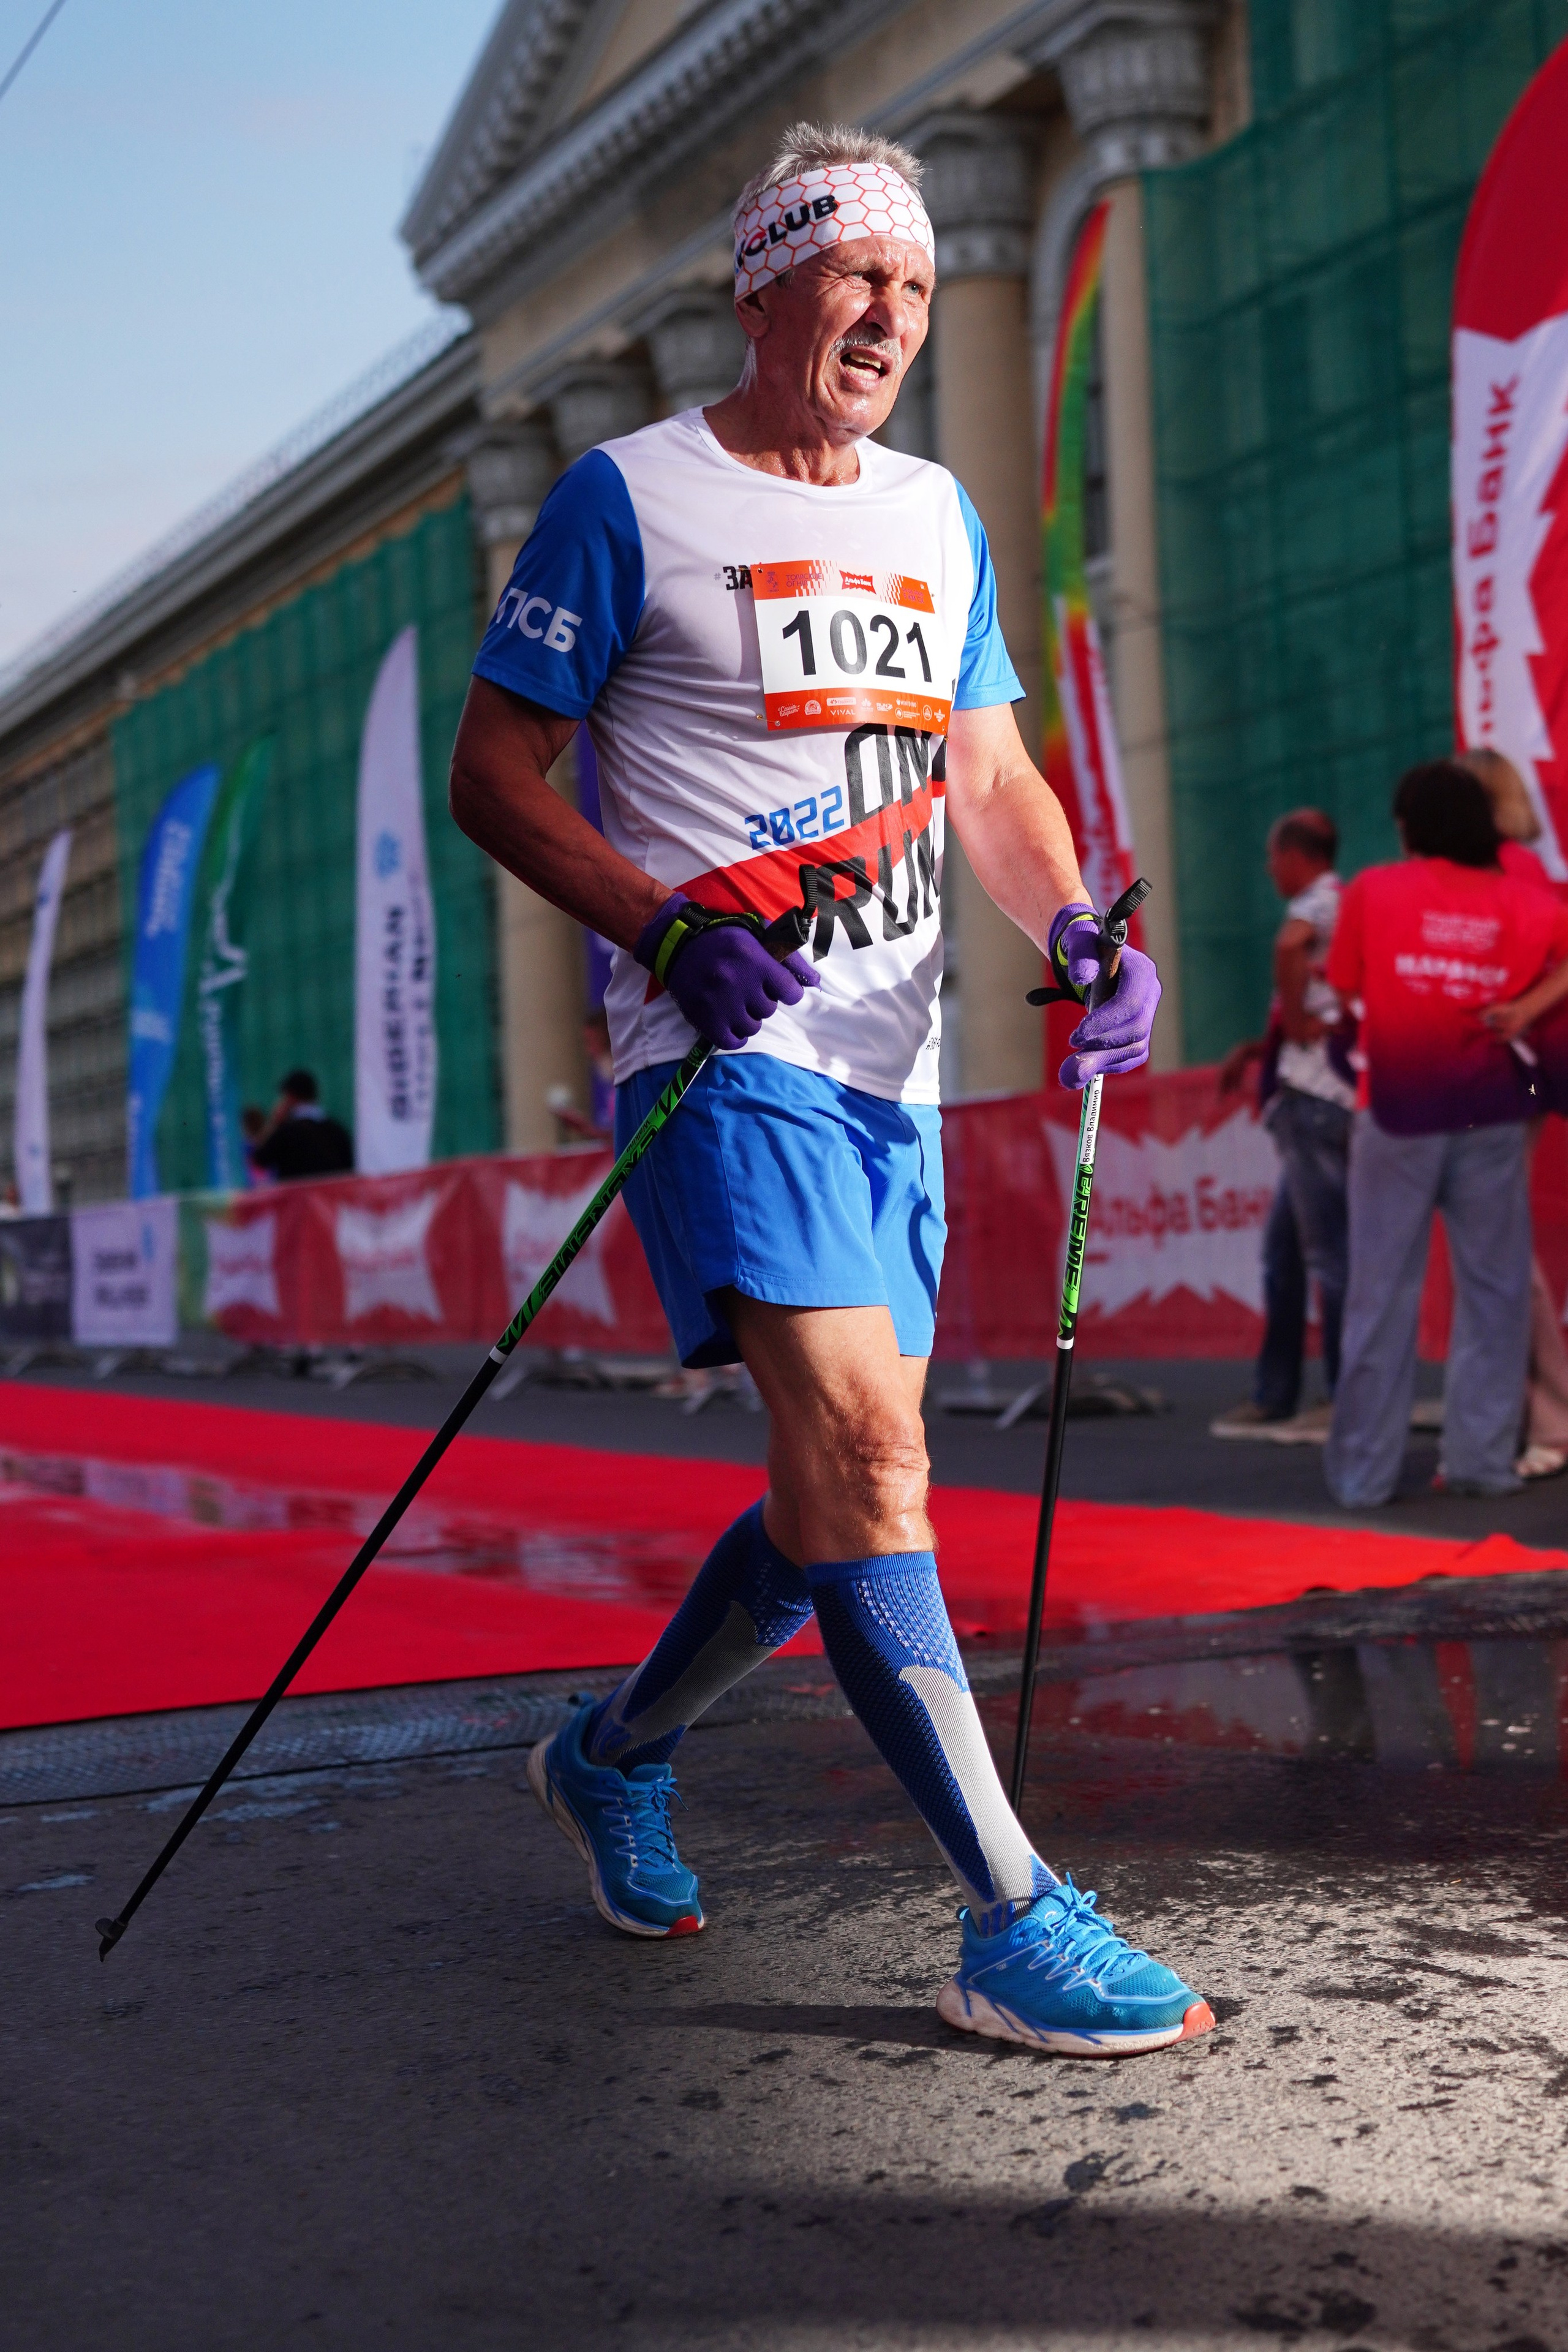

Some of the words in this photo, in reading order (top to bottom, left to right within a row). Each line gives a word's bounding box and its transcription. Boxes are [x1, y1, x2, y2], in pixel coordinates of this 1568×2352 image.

[495, 587, 583, 653] ПСБ
[782, 609, 932, 683] 1021
[744, 785, 845, 850] 2022
[813, 824, 940, 963] RUN
[1087, 1090, 1100, 1132] Владимир
[1082, 1134, 1093, 1163] Вязков
